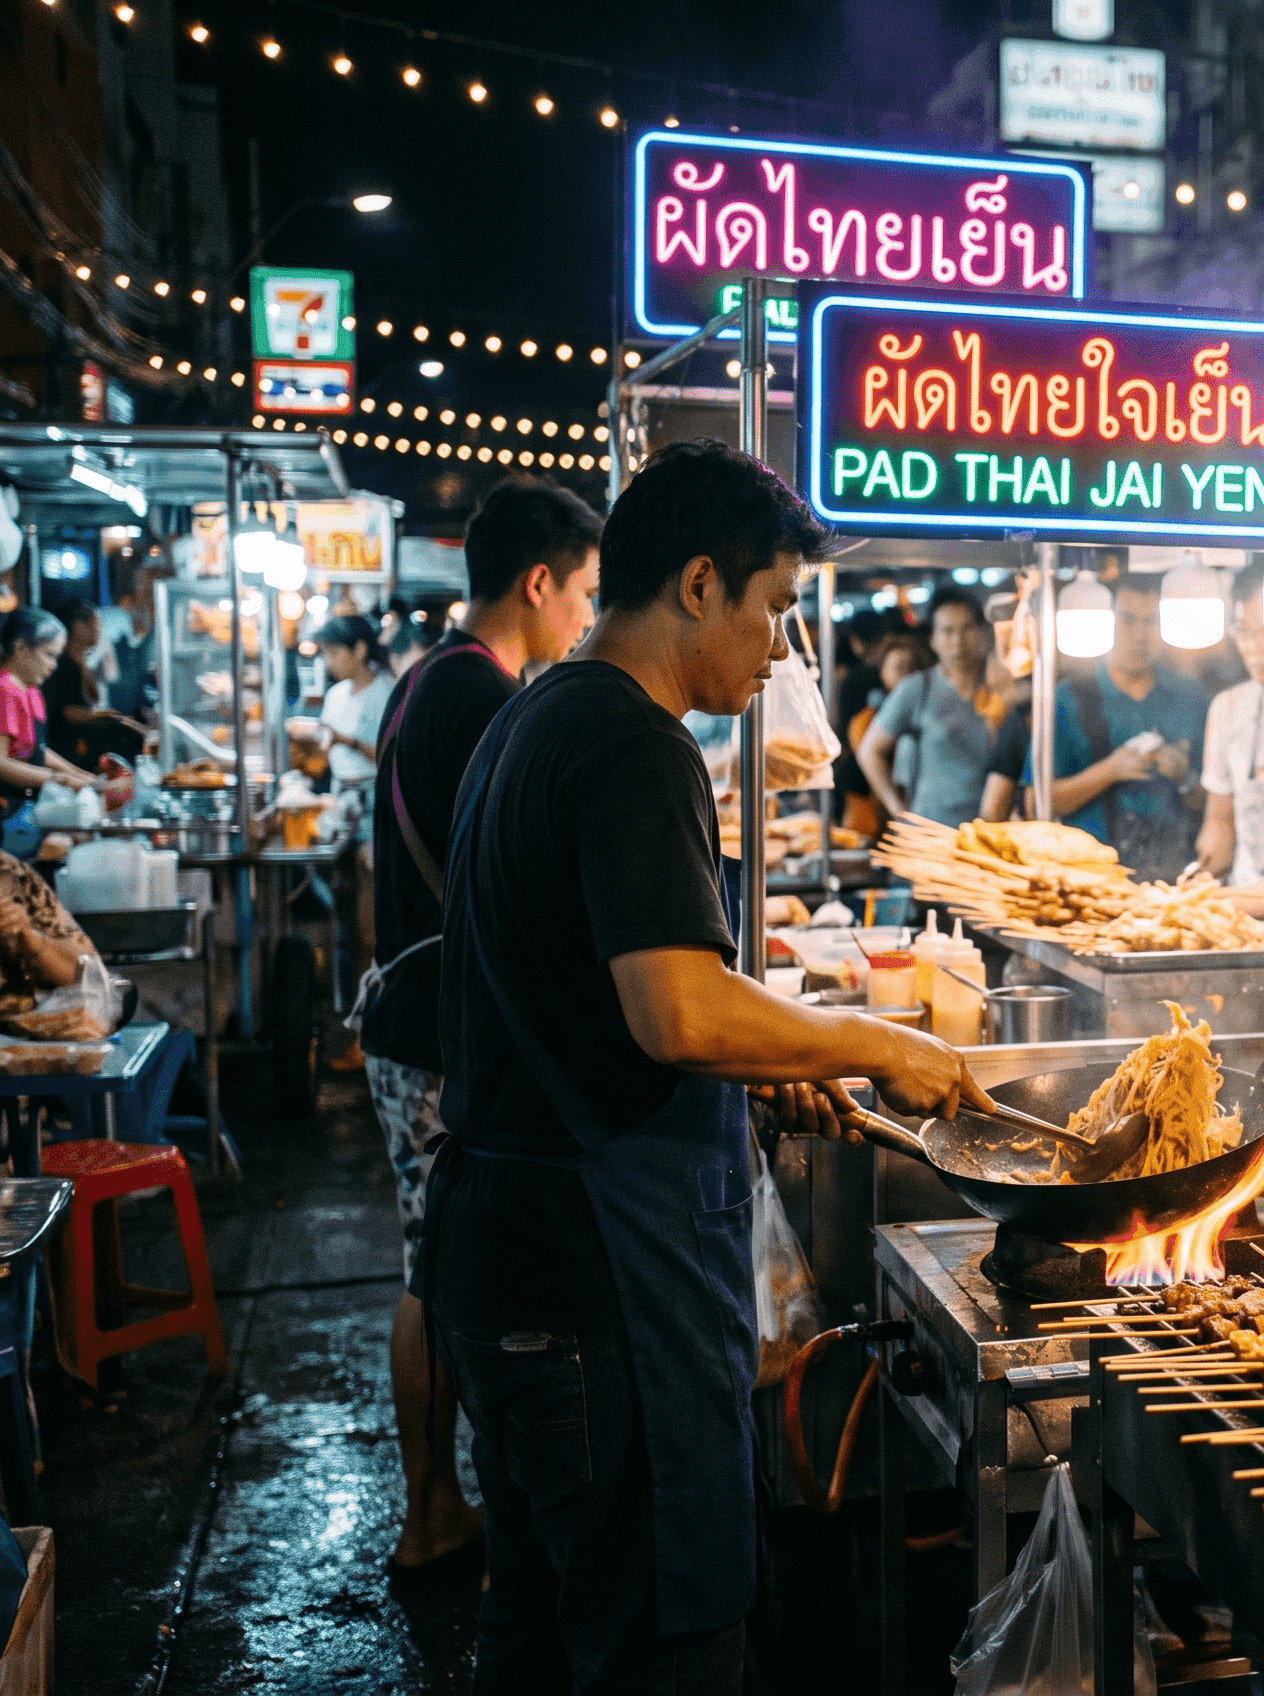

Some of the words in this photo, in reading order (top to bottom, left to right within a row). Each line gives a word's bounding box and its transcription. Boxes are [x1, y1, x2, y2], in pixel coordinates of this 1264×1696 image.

[656, 158, 1069, 292] ผัดไทยเย็น
[833, 447, 938, 500] PAD
[955, 453, 1071, 505] THAI
[1090, 459, 1163, 509] JAI
